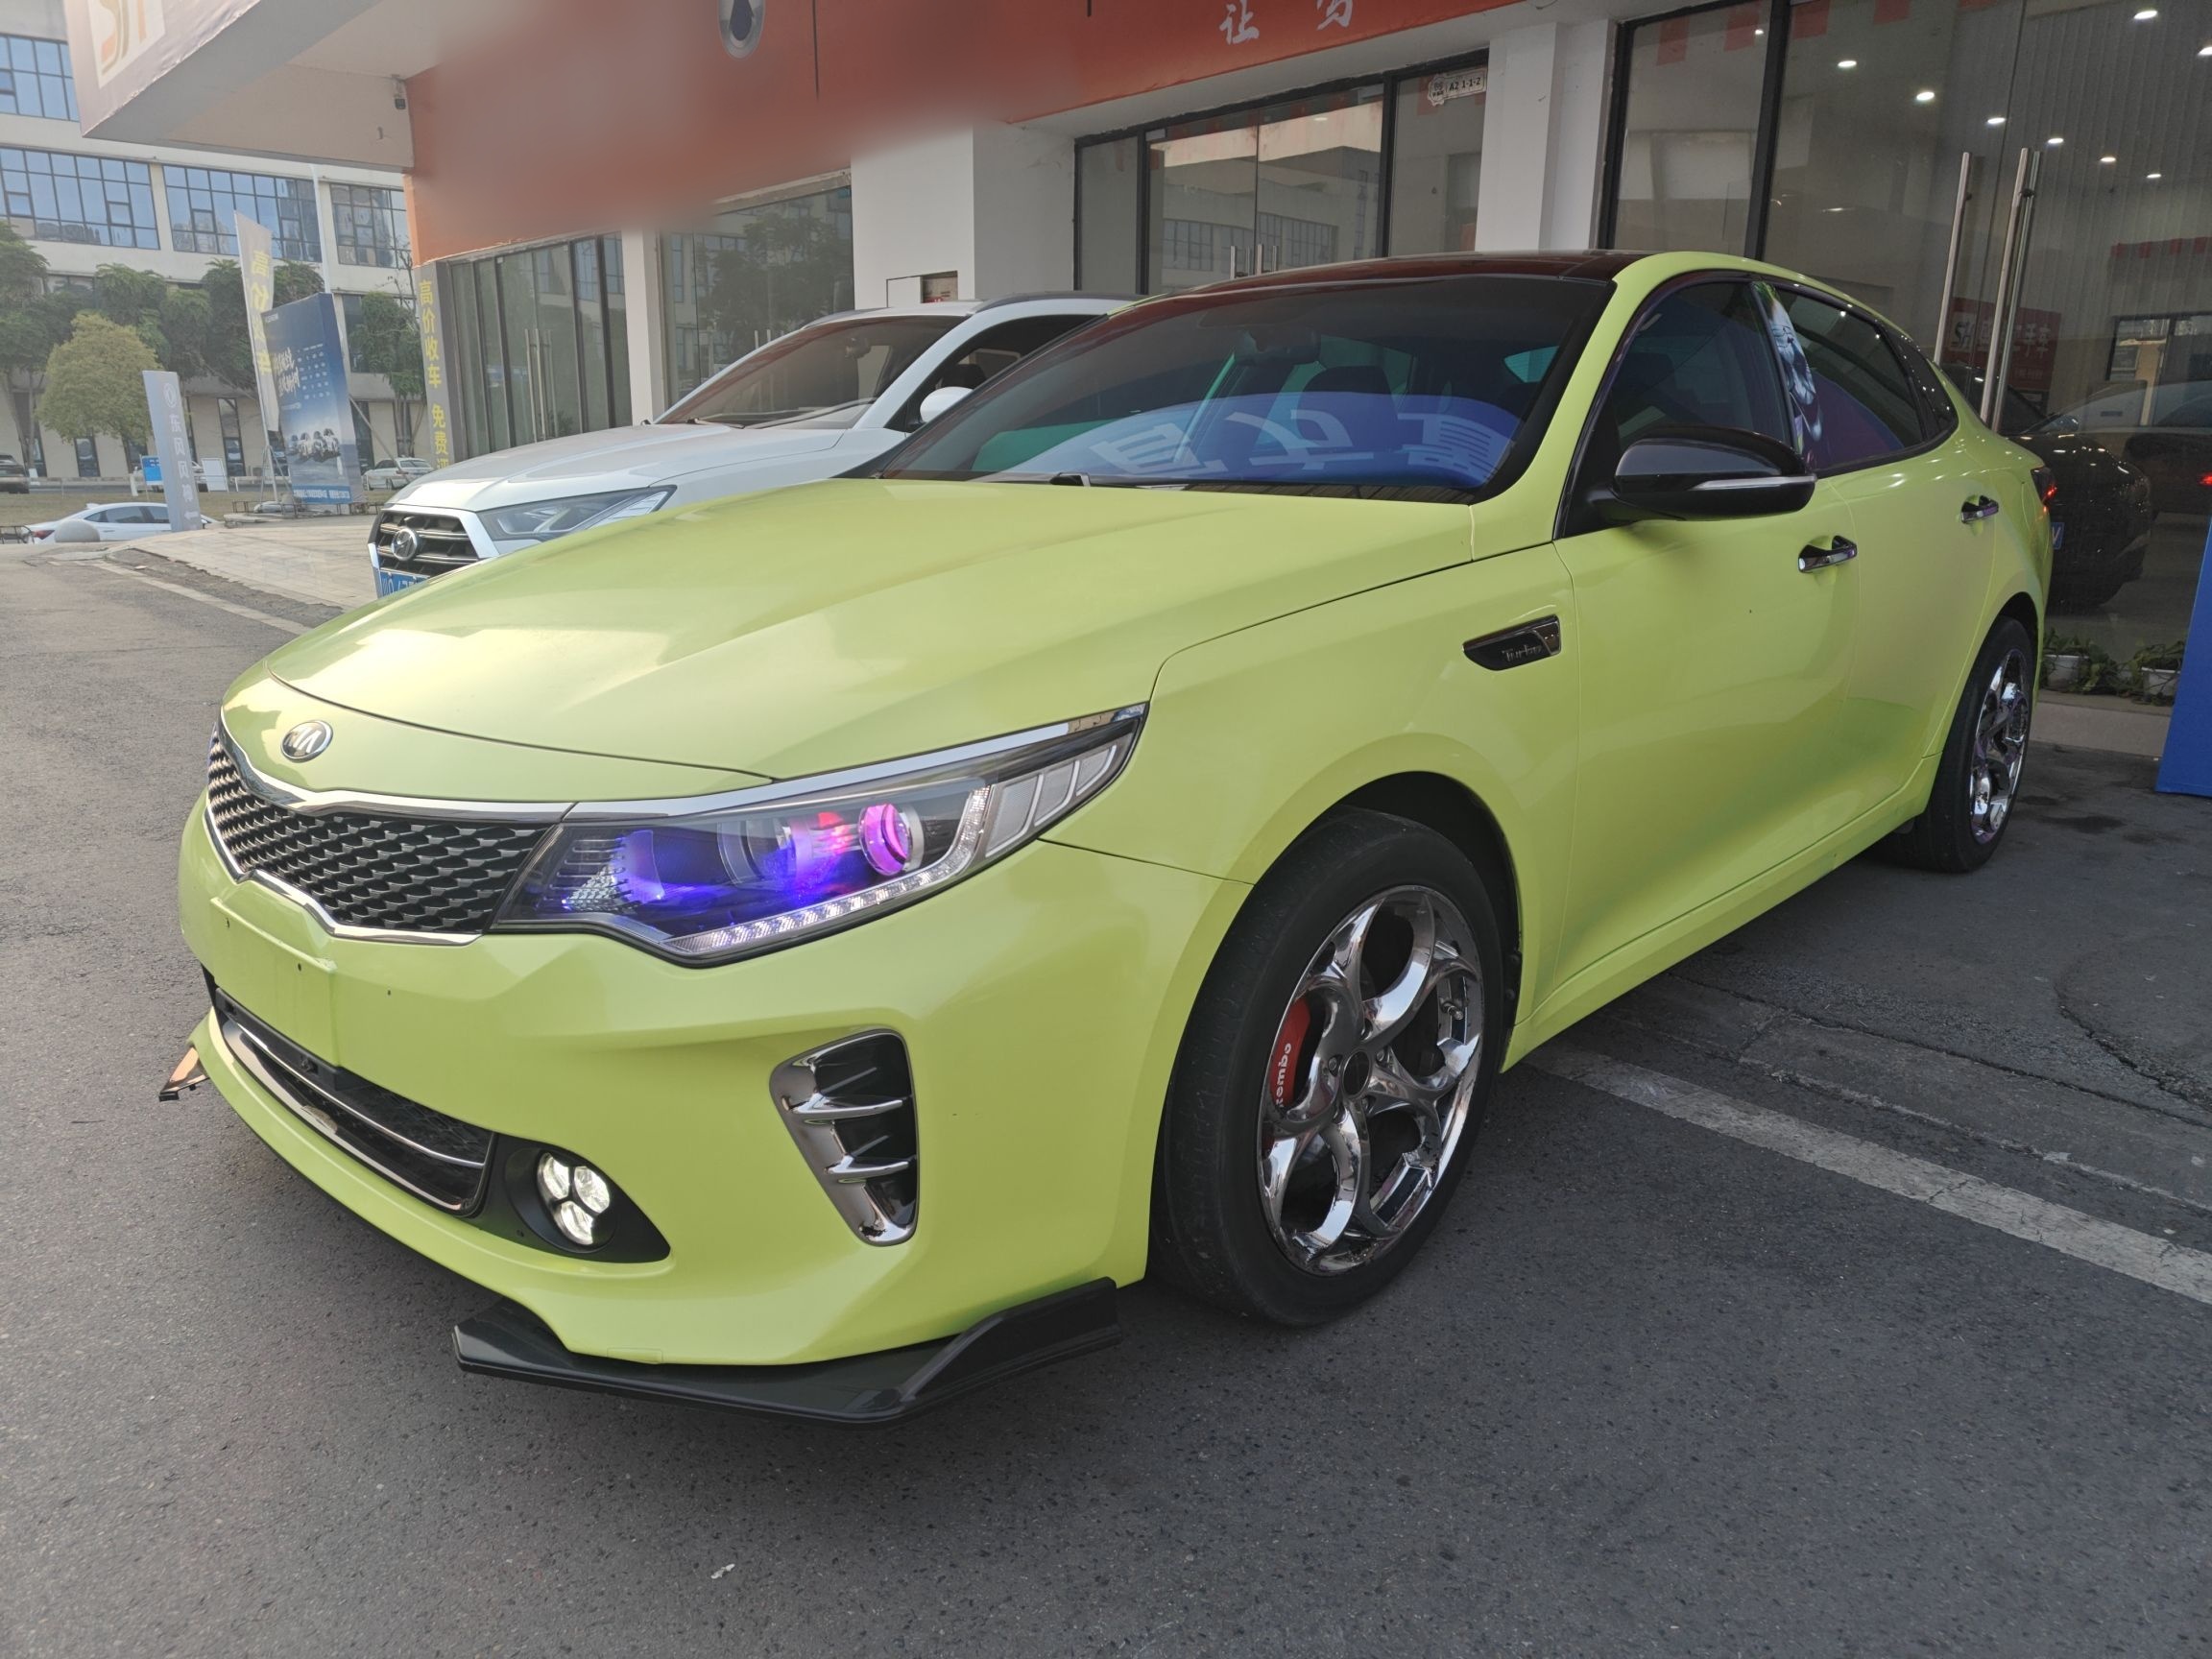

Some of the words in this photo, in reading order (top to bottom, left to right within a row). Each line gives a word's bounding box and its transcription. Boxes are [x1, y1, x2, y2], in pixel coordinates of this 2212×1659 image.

[419, 279, 442, 389] 高价收车
[168, 414, 194, 502] 东风风神
[1275, 1043, 1292, 1108] rembo
